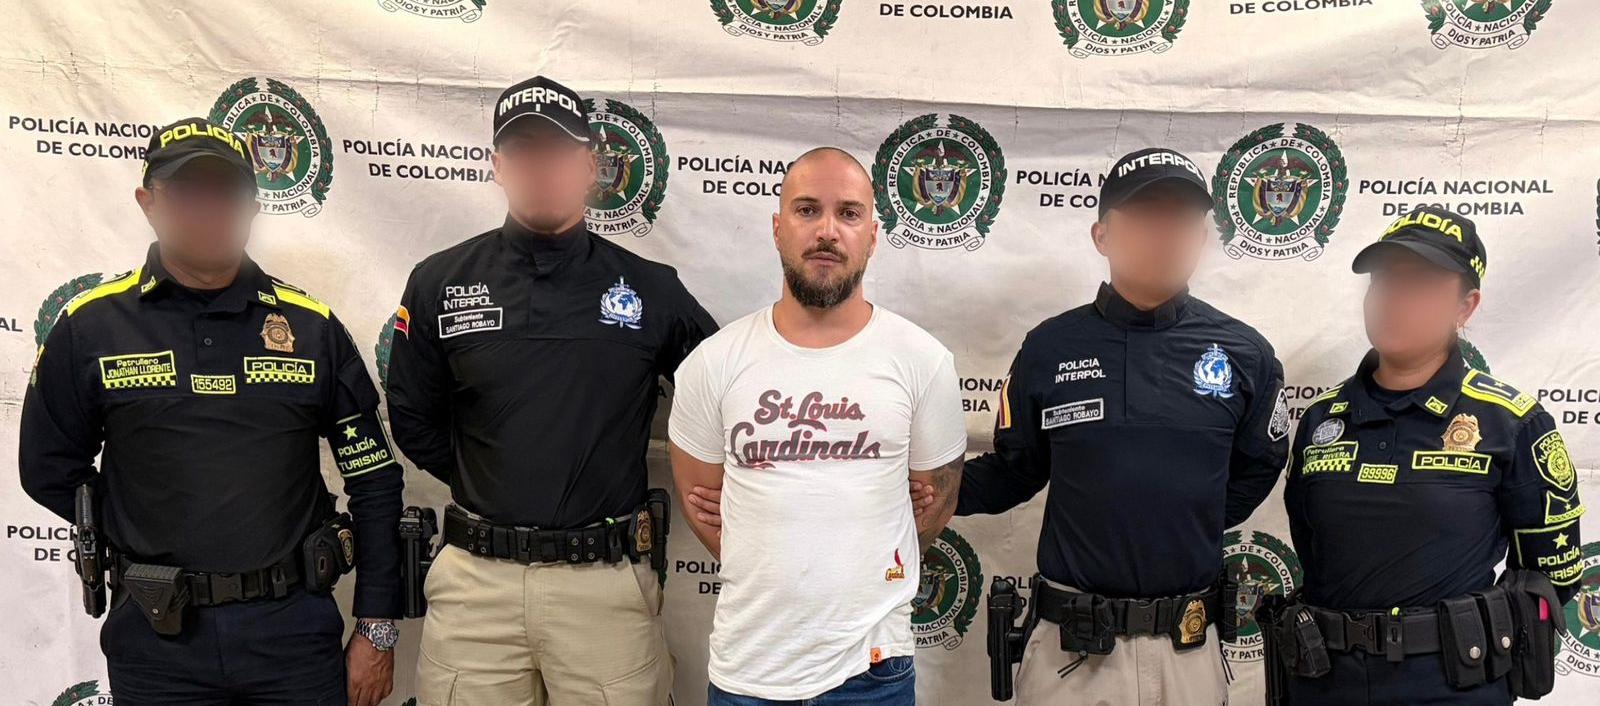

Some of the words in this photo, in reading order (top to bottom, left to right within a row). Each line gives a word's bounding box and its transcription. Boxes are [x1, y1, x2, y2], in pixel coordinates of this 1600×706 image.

[430, 5, 467, 16] PATRIA
[880, 3, 904, 16] DE
[910, 5, 1013, 19] COLOMBIA
[1230, 3, 1255, 14] DE
[1445, 2, 1472, 30] OLICIA
[774, 11, 822, 31] NACIONAL
[739, 24, 762, 37] DIOS
[773, 32, 808, 40] PATRIA
[1121, 16, 1168, 44] NACIONAL
[1448, 29, 1470, 44] DIOS
[1479, 29, 1515, 46] PATRIA
[1085, 43, 1110, 54] DIOS
[1120, 40, 1157, 53] PATRIA
[499, 87, 582, 118] INTERPOL
[9, 116, 89, 135] POLICÍA
[225, 97, 252, 130] UBLICA
[260, 93, 273, 102] DE
[283, 101, 319, 158] COLOMBIA
[37, 140, 62, 154] DE
[69, 143, 148, 160] COLOMB
[343, 139, 415, 157] POLICÍA
[596, 113, 610, 122] DE
[622, 120, 653, 176] COLOMBIA
[678, 155, 753, 173] POLICÍA
[889, 134, 925, 187] REPUBLICA
[936, 129, 951, 137] DE
[961, 136, 990, 190] COLOMBIA
[369, 163, 391, 177] DE
[1016, 169, 1092, 187] POLICÍA
[1229, 144, 1269, 199] REPUBLICA
[1280, 139, 1296, 147] DE
[1305, 145, 1331, 201] COLOMBIA
[273, 169, 317, 199] NACIONAL
[703, 180, 727, 194] DE
[1359, 177, 1437, 194] POLICÍA
[1443, 180, 1554, 194] NACIONAL
[272, 198, 307, 212] PATRIA
[603, 186, 650, 219] NACIONAL
[1040, 194, 1064, 207] DE
[936, 202, 983, 233] NACIONAL
[1382, 203, 1408, 216] DE
[594, 223, 601, 231] Y
[603, 218, 637, 232] PATRIA
[1275, 212, 1323, 244] NACIONAL
[902, 229, 925, 245] DIOS
[926, 238, 934, 246] Y
[936, 231, 970, 247] PATRIA
[1240, 240, 1263, 255] DIOS
[1263, 249, 1271, 257] Y
[1273, 242, 1309, 257] PATRIA
[471, 319, 496, 329] ROBAYO
[107, 366, 139, 379] JONATHAN
[140, 362, 171, 374] LLORENTE
[116, 358, 159, 367] Patrullero
[252, 361, 307, 375] POLICÍA
[1059, 358, 1100, 372] POLICIA
[195, 378, 232, 390] 155492
[1055, 369, 1106, 384] INTERPOL
[754, 389, 797, 425] St.
[787, 391, 866, 432] Louis
[1073, 409, 1099, 420] ROBAYO
[1562, 411, 1588, 424] DE
[338, 436, 377, 457] POLICÍA
[730, 421, 882, 469] Cardinals
[338, 449, 388, 471] TURISMO
[1322, 451, 1350, 460] RIVERA
[1420, 456, 1481, 470] POLICÍA
[1361, 467, 1394, 480] 99996
[35, 548, 60, 561] DE
[940, 543, 967, 594] COLOMBIA
[1240, 545, 1255, 553] DE
[1264, 552, 1293, 593] COLOMB
[699, 582, 721, 594] DE
[917, 605, 961, 632] NACIONAL
[916, 630, 949, 645] PATRIA
[1240, 647, 1264, 659] PATR
[1567, 655, 1592, 672] DIOS
[1593, 665, 1600, 673] Y
[98, 697, 114, 705] DE
